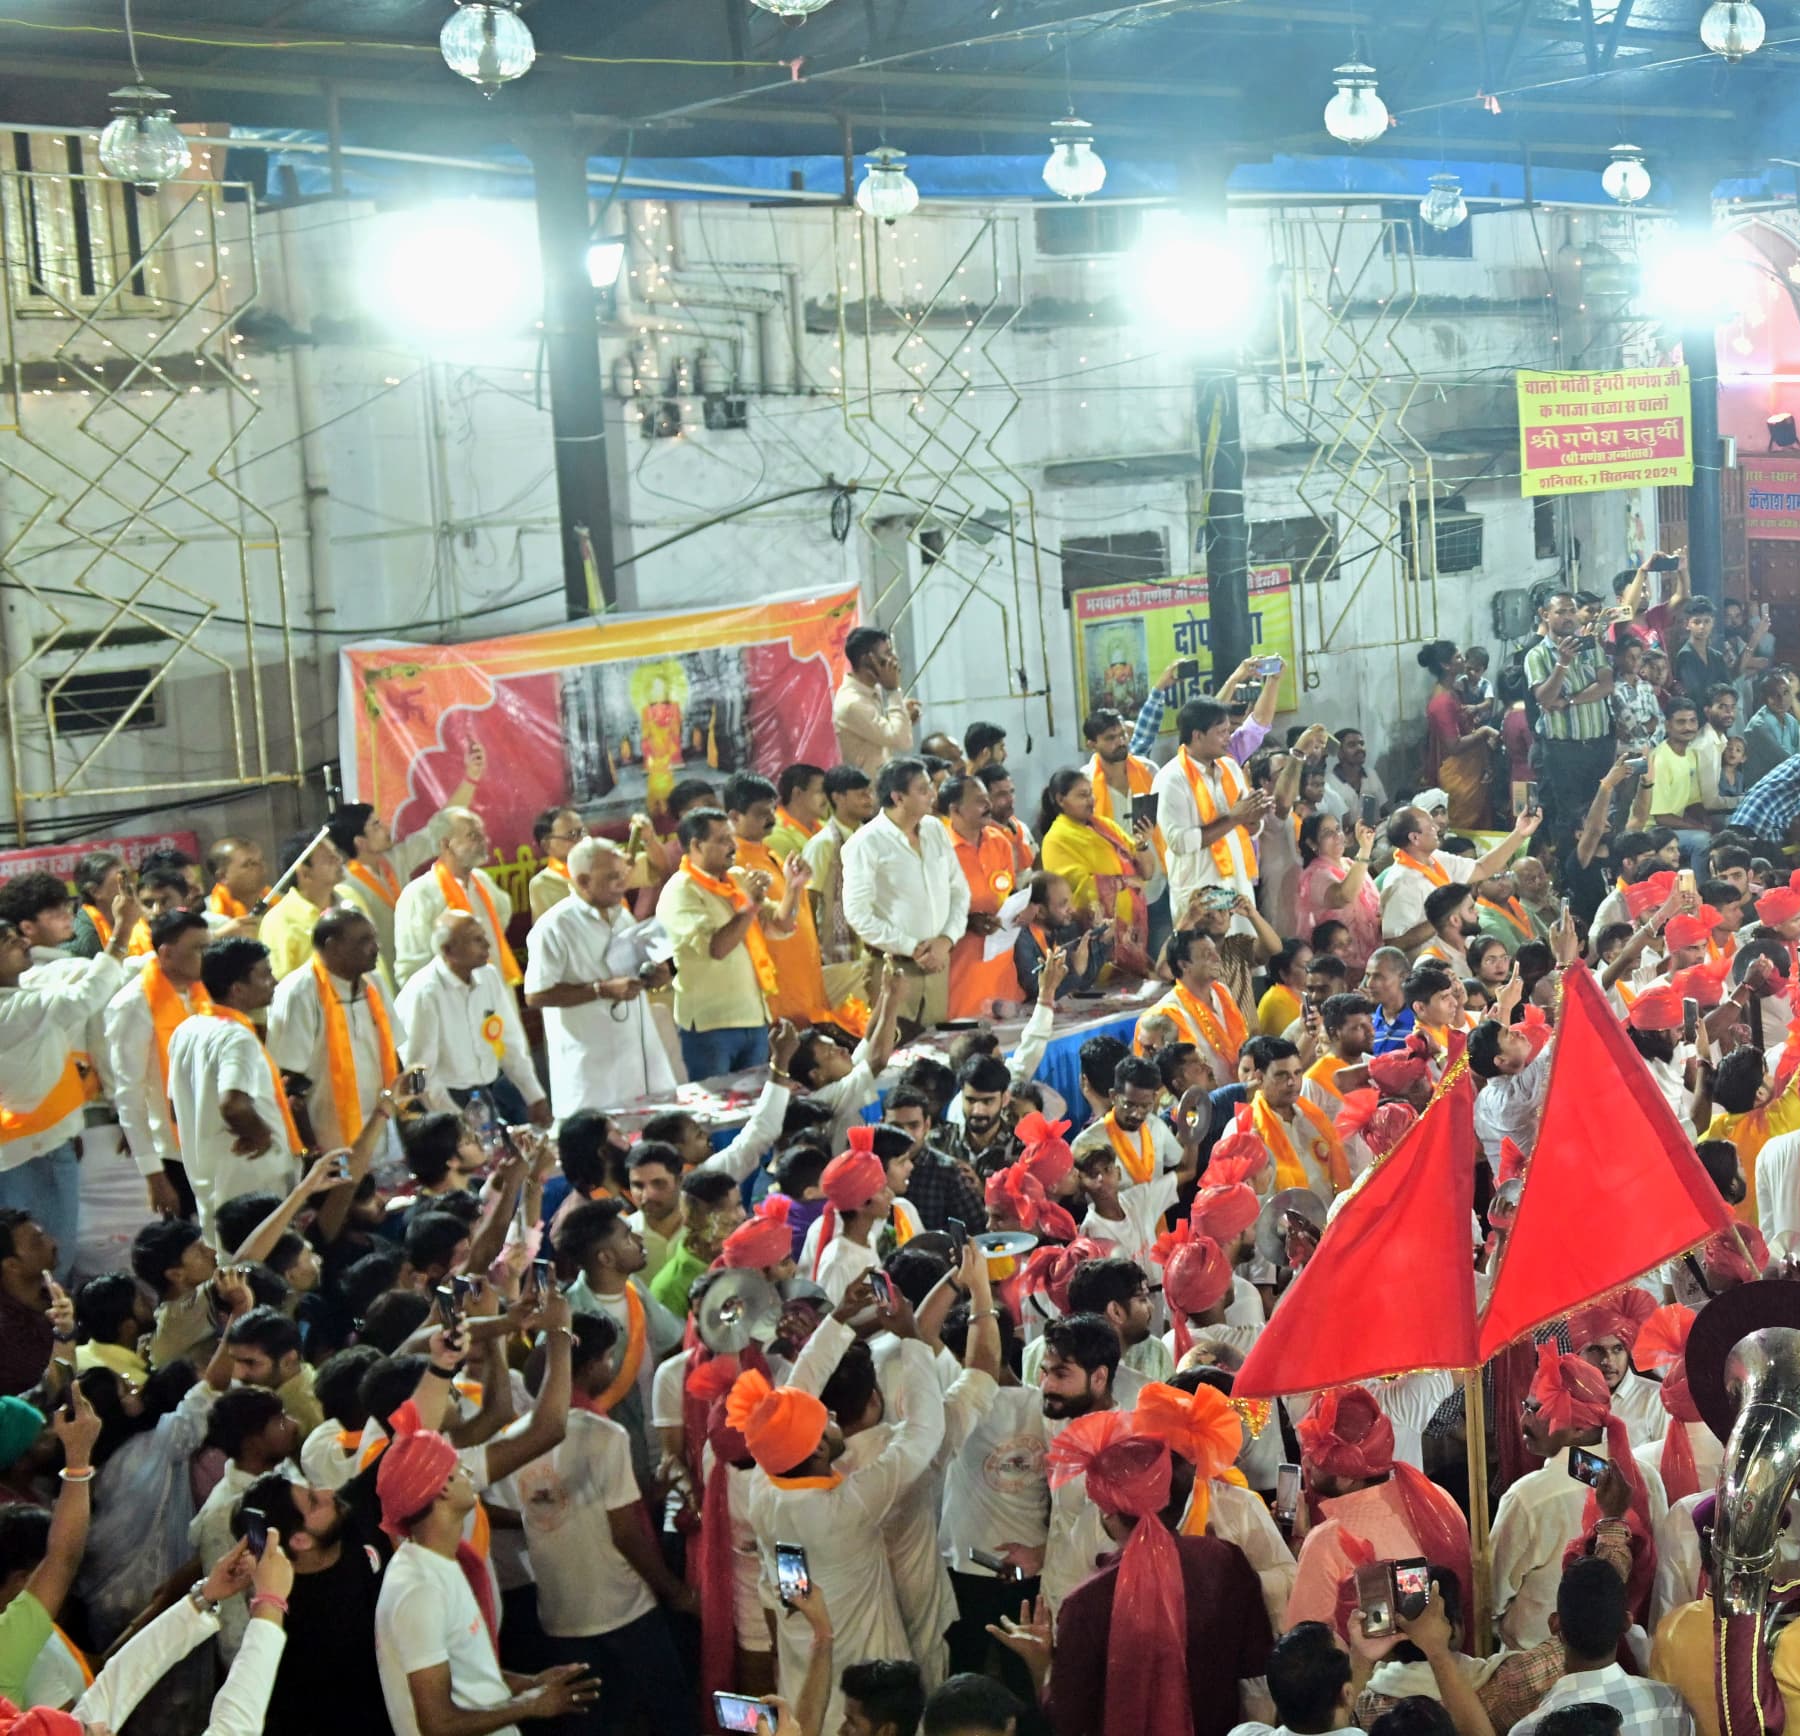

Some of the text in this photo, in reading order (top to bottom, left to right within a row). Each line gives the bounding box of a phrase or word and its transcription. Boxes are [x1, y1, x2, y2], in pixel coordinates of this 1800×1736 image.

[1664, 369, 1681, 386] जी
[1530, 419, 1681, 449] श्री गणेश चतुर्थी
[1590, 474, 1597, 485] 7
[1600, 468, 1642, 484] सितम्बर
[1645, 466, 1679, 479] 2024
